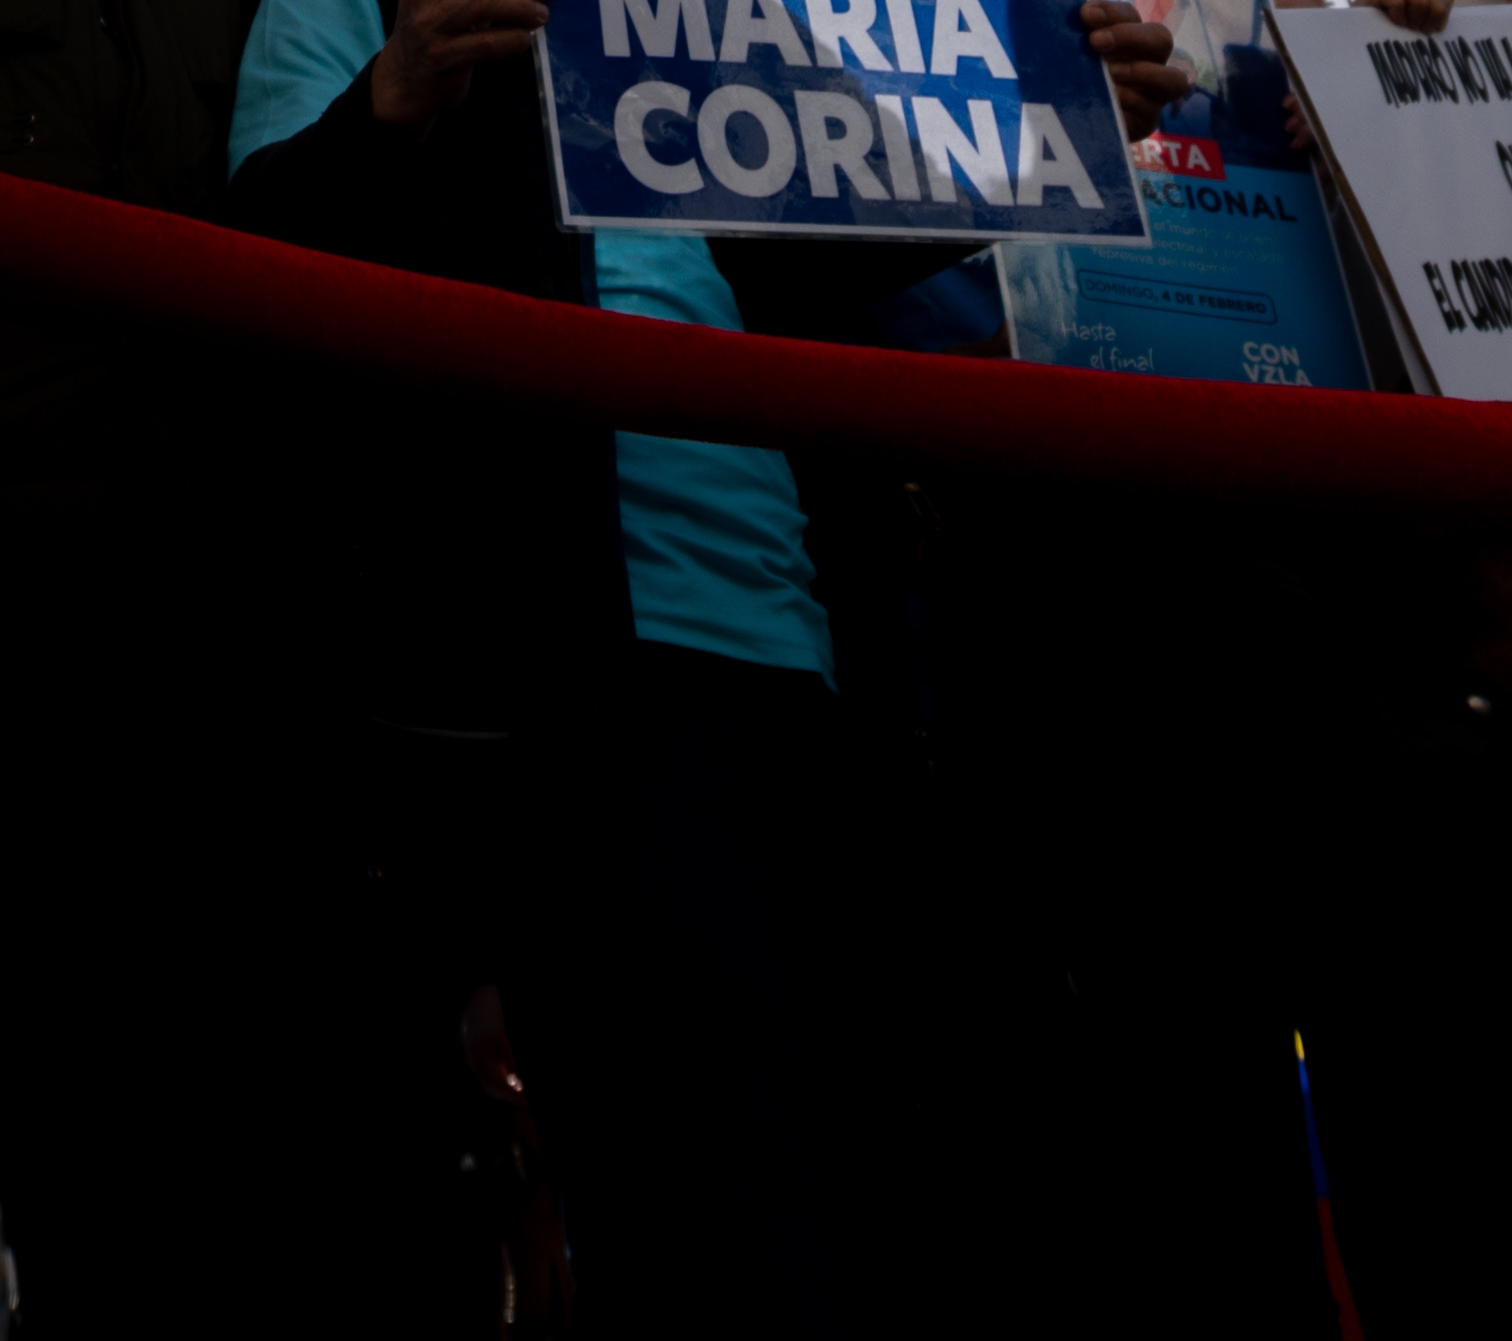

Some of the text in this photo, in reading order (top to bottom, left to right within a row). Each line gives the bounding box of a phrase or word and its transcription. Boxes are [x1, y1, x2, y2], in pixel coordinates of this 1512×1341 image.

[1365, 34, 1459, 109] MADURO
[1443, 35, 1490, 104] NO
[613, 80, 1105, 210] CORINA
[1085, 277, 1267, 315] DOMINGO, 4 DE FEBRERO
[1422, 260, 1467, 334] EL
[1062, 321, 1117, 343] Hasta
[1090, 347, 1156, 372] el final
[1242, 340, 1301, 367] CON
[1243, 362, 1314, 387] VZLA
